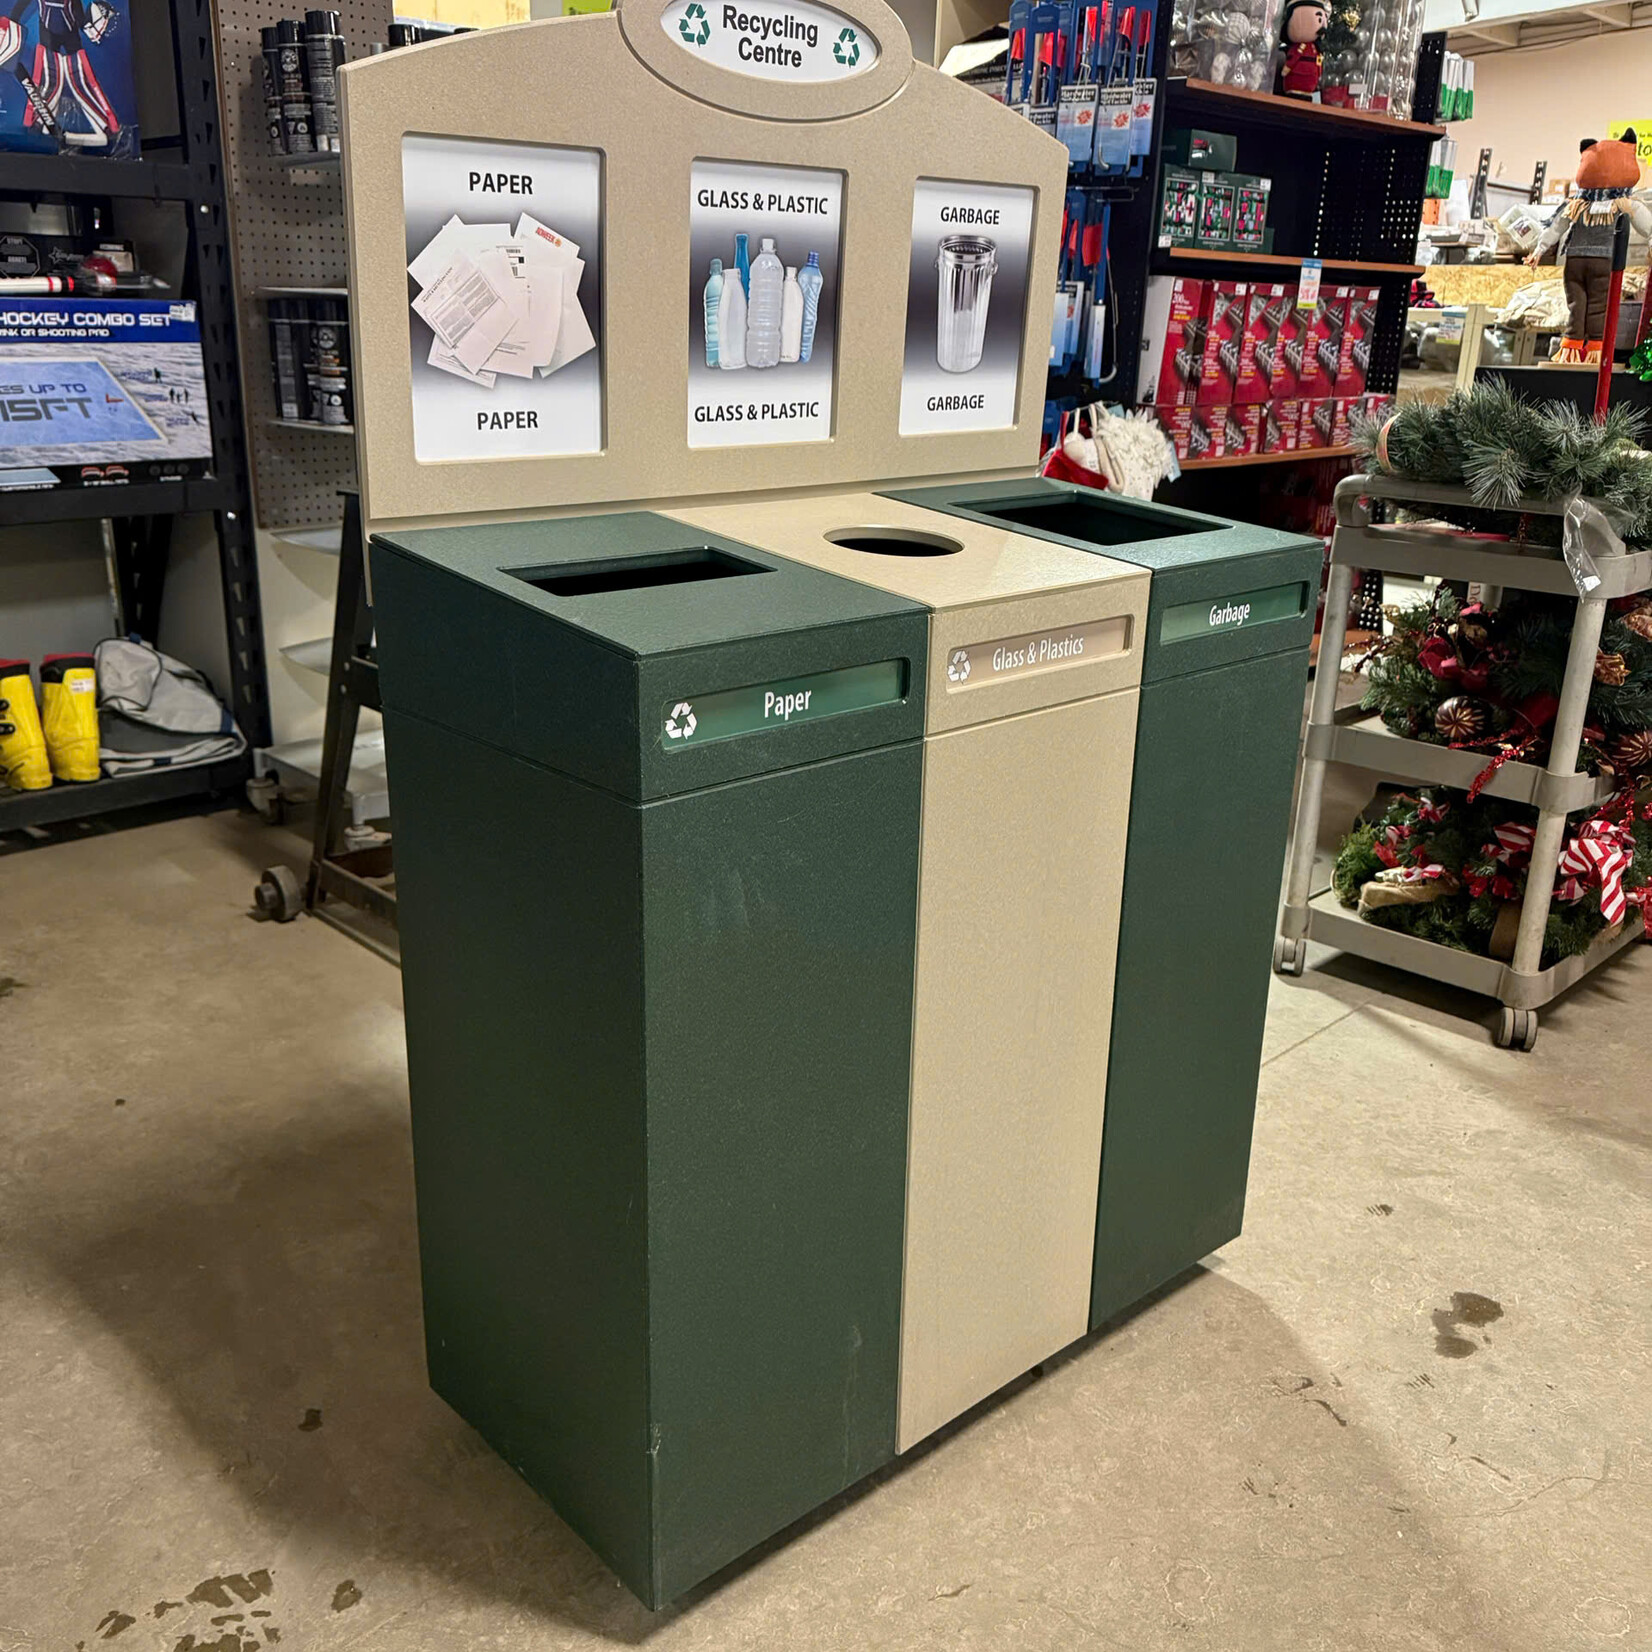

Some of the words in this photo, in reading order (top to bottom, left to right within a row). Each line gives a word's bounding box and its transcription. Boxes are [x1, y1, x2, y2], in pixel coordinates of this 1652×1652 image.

[722, 4, 819, 48] Recycling
[738, 37, 802, 68] Centre
[469, 171, 533, 195] PAPER
[697, 189, 749, 210] GLASS
[752, 192, 764, 211] &
[767, 193, 829, 215] PLASTIC
[940, 206, 1000, 225] GARBAGE
[0, 311, 69, 326] HOCKEY
[73, 312, 135, 326] COMBO
[139, 313, 171, 327] SET
[0, 328, 19, 337] INK
[20, 328, 36, 337] OR
[37, 328, 87, 337] SHOOTING
[29, 384, 55, 394] UP
[61, 382, 87, 392] TO
[694, 404, 743, 422] GLASS
[747, 404, 758, 420] &
[761, 401, 819, 420] PLASTIC
[927, 394, 985, 412] GARBAGE
[477, 410, 538, 430] PAPER
[1208, 601, 1251, 627] Garbage
[992, 647, 1024, 672] Glass
[1026, 641, 1037, 665] &
[1039, 633, 1084, 662] Plastics
[764, 689, 812, 721] Paper
